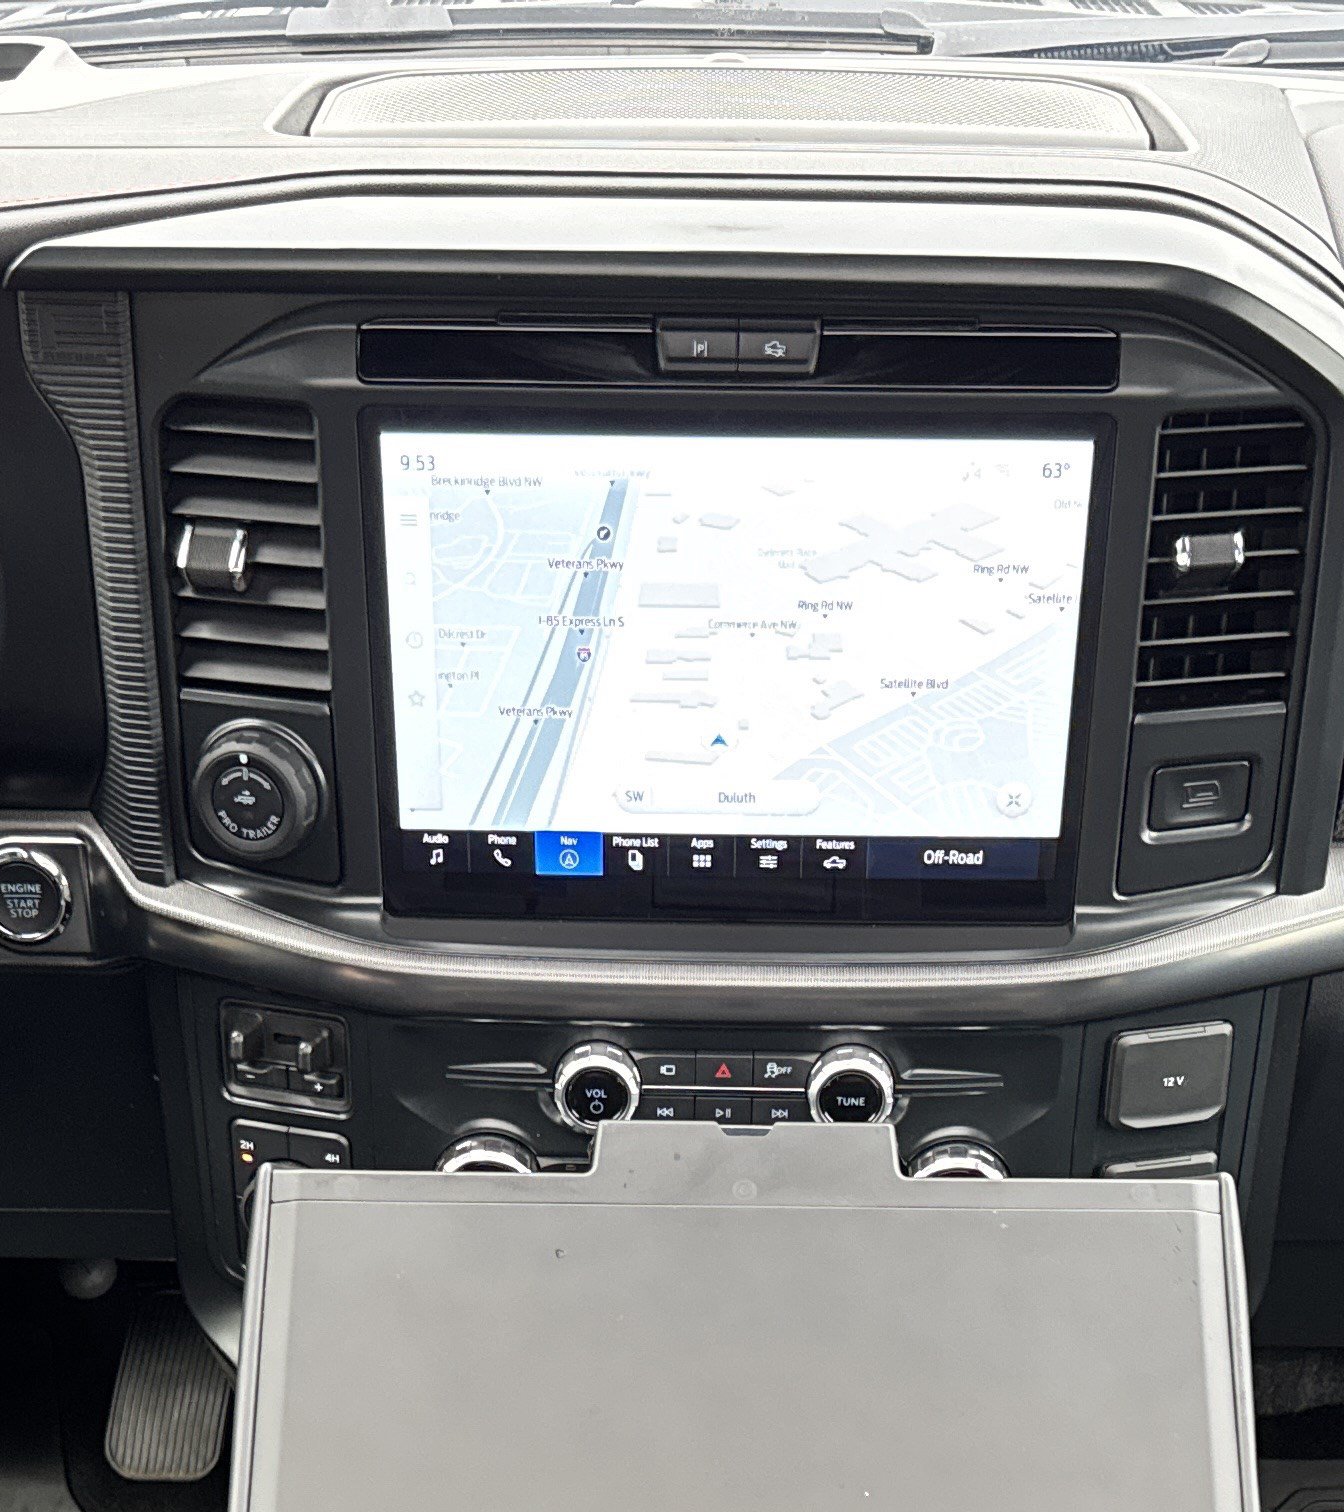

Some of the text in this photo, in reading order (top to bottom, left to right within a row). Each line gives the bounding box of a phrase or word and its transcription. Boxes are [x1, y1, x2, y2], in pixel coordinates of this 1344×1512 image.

[498, 476, 522, 487] Blvd
[524, 477, 543, 487] NW
[548, 558, 624, 571] Veterans Pkwy
[973, 564, 1030, 576] Ring Rd NW
[798, 600, 854, 612] Ring Rd NW
[562, 616, 601, 629] Express
[603, 616, 616, 627] Ln
[617, 616, 625, 627] S
[760, 619, 779, 630] Ave
[780, 620, 798, 630] NW
[880, 678, 949, 690] Satellite Blvd
[498, 706, 573, 719] Veterans Pkwy
[624, 791, 645, 803] SW
[718, 792, 756, 804] Duluth
[217, 810, 281, 839] PRO TRAILER
[423, 833, 449, 845] Audio
[487, 834, 517, 846] Phone
[560, 835, 578, 846] Nav
[612, 837, 659, 848] Phone List
[691, 838, 714, 849] Apps
[750, 838, 788, 851] Settings
[816, 839, 855, 850] Features
[923, 849, 984, 865] Off-Road
[0, 883, 42, 894] ENGINE
[6, 899, 40, 909] START
[9, 908, 39, 918] STOP
[777, 1067, 793, 1076] OFF
[1163, 1075, 1185, 1087] 12 V
[585, 1088, 607, 1099] VOL
[837, 1096, 865, 1107] TUNE
[239, 1140, 255, 1151] 2H
[325, 1153, 340, 1163] 4H
